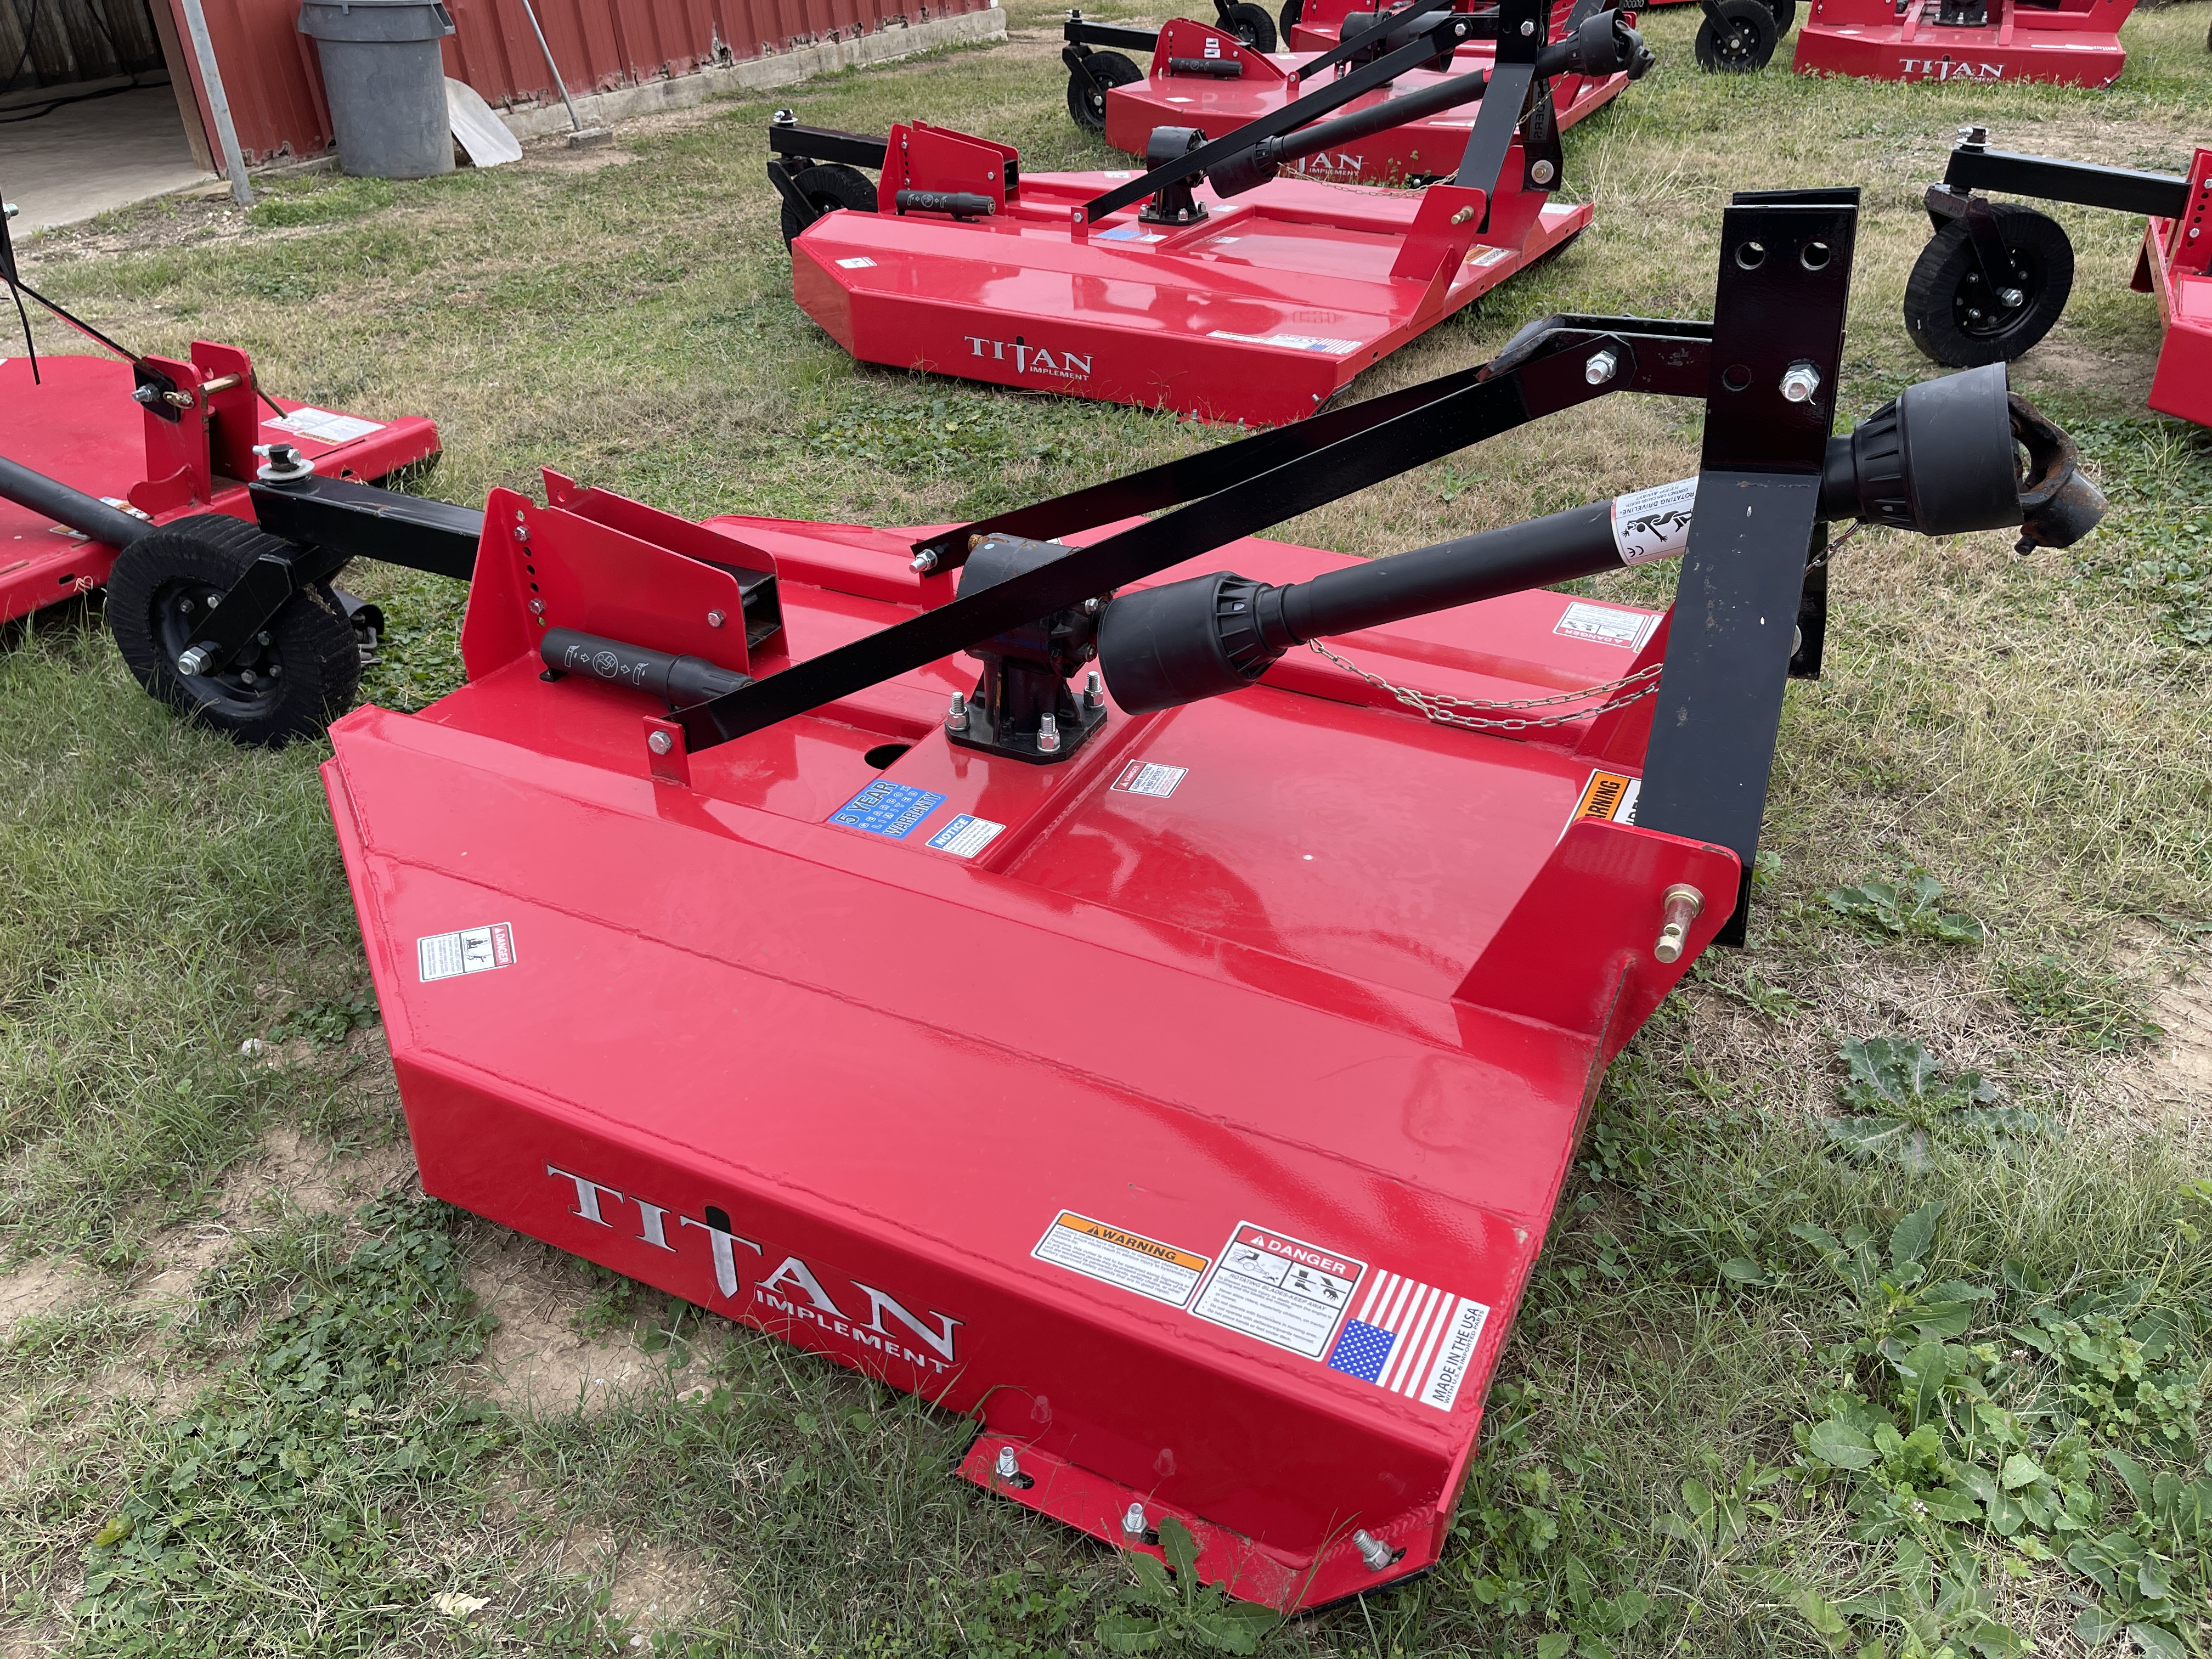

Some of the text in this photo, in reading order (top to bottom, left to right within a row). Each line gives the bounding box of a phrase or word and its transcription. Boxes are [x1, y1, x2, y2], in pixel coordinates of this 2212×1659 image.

[1899, 55, 2005, 81] TITAN
[964, 336, 1094, 374] TITAN
[1030, 366, 1089, 381] IMPLEMENT
[1660, 491, 1694, 505] ROTATING
[1667, 488, 1688, 496] CONTACT
[1565, 629, 1612, 641] DANGER
[1124, 766, 1140, 782] DANGER
[836, 782, 898, 825] 5 YEAR
[859, 786, 912, 828] GEARBOX
[871, 791, 918, 829] LIMITED
[882, 792, 941, 837] WARRANTY
[1585, 780, 1621, 818] RNING
[935, 818, 969, 845] NOTICE
[495, 933, 509, 963] DANGER
[1102, 1229, 1177, 1260] WARNING
[1267, 1239, 1346, 1274] DANGER
[546, 1165, 965, 1362] TITAN
[1229, 1273, 1326, 1310] ROTATING BLADES-KEEP AWAY
[757, 1289, 951, 1374] IMPLEMENT
[1432, 1308, 1479, 1401] MADE IN THE USA
[1444, 1385, 1454, 1403] WITH
[1452, 1372, 1460, 1384] U.S.
[1460, 1330, 1475, 1364] IMPORTED
[1473, 1310, 1483, 1329] PARTS
